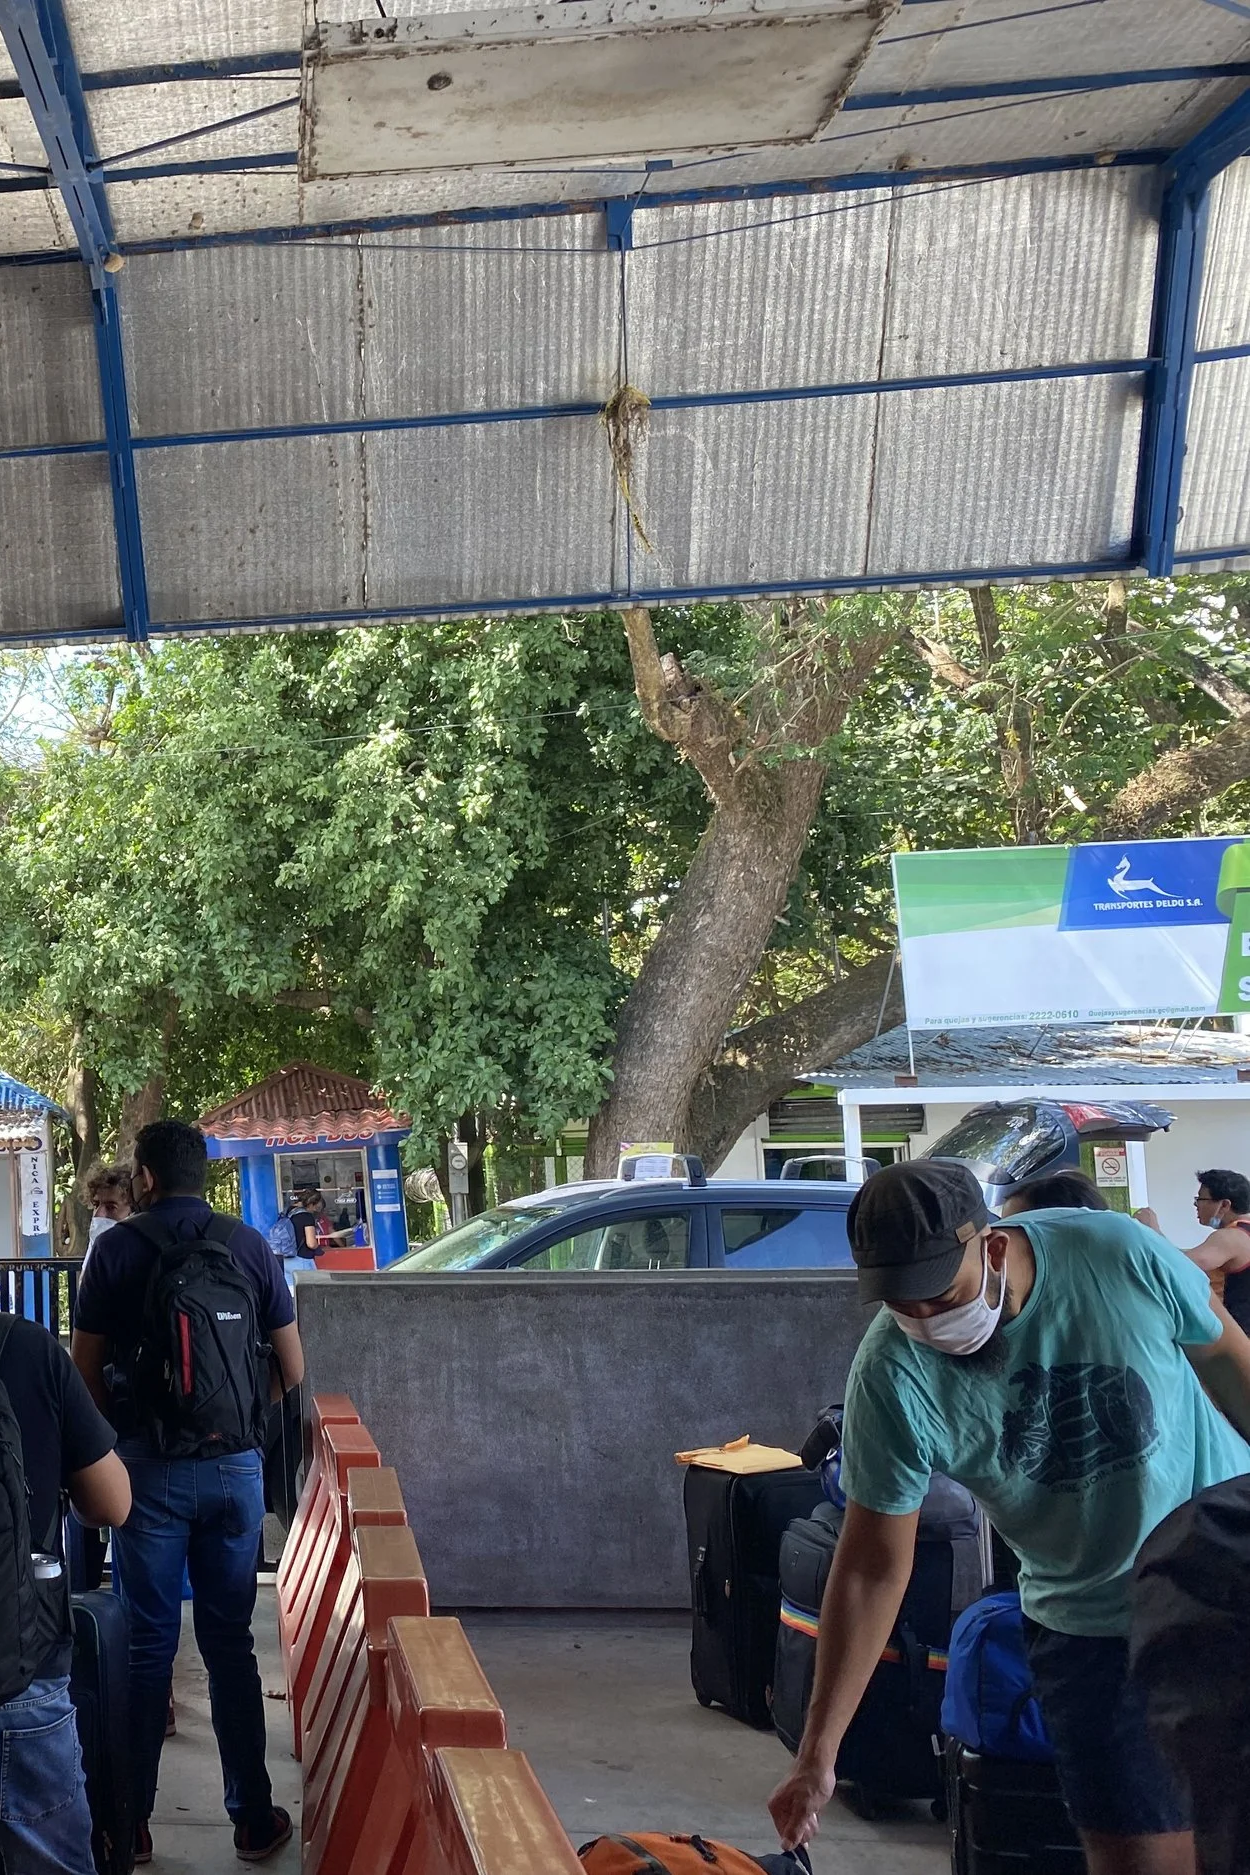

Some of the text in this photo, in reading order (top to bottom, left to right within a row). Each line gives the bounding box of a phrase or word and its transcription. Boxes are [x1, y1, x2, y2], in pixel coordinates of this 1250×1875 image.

[1093, 898, 1203, 911] TRANSPORTES DELDU S.A.
[944, 1016, 969, 1025] quejas
[972, 1016, 976, 1024] y
[1029, 1010, 1079, 1020] 2222-0610
